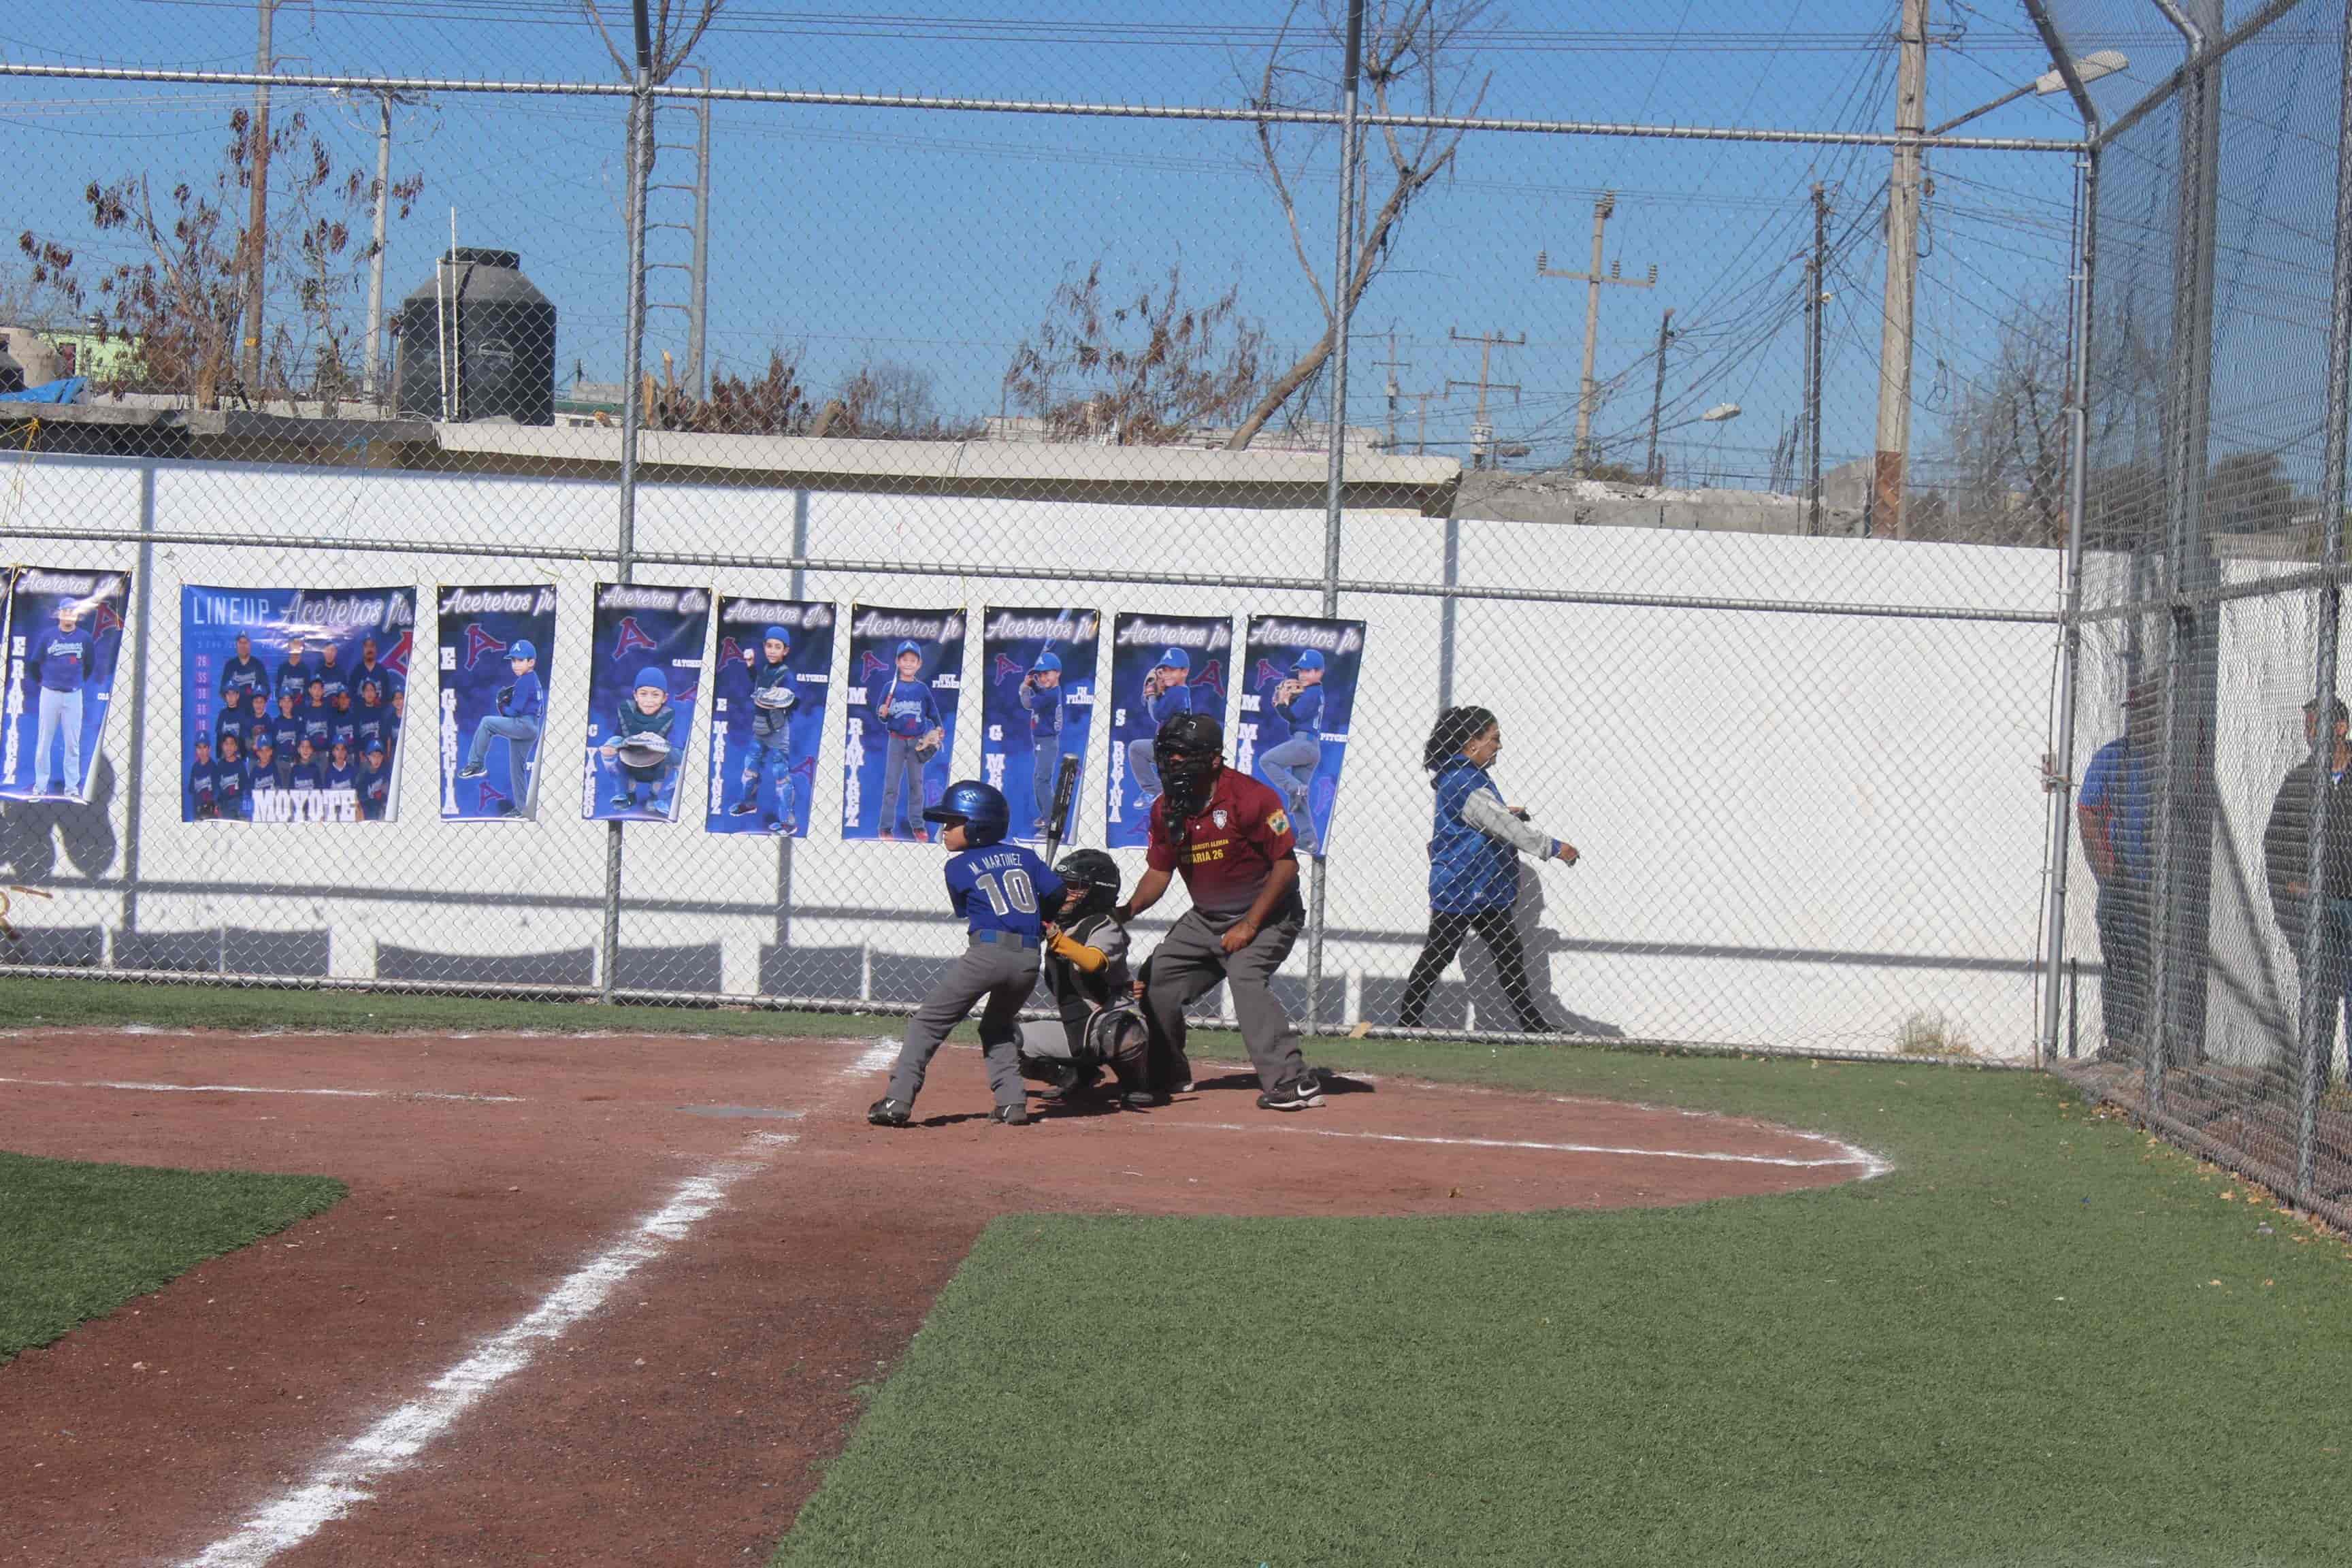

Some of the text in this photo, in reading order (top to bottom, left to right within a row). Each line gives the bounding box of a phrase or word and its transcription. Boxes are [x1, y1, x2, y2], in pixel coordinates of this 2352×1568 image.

[18, 570, 91, 592] Acereros
[193, 596, 270, 625] LINEUP
[278, 591, 385, 627] Acereros
[439, 589, 532, 615] Acereros
[599, 587, 674, 608] Acereros
[724, 600, 800, 622] Acereros
[852, 612, 938, 638] Acereros
[985, 613, 1072, 638] Acereros
[1116, 619, 1207, 644] Acereros
[1247, 619, 1335, 647] Acereros
[440, 647, 457, 670] E
[716, 698, 728, 712] E
[1241, 694, 1261, 713] M
[587, 724, 598, 737] C
[988, 724, 1004, 741] G
[845, 687, 868, 828] M RAMIREZ
[1109, 708, 1127, 823] S REYNA
[252, 789, 357, 822] MOYOTE
[981, 853, 1023, 870] MARTINEZ
[1213, 849, 1224, 860] 26
[975, 868, 1037, 917] 10
